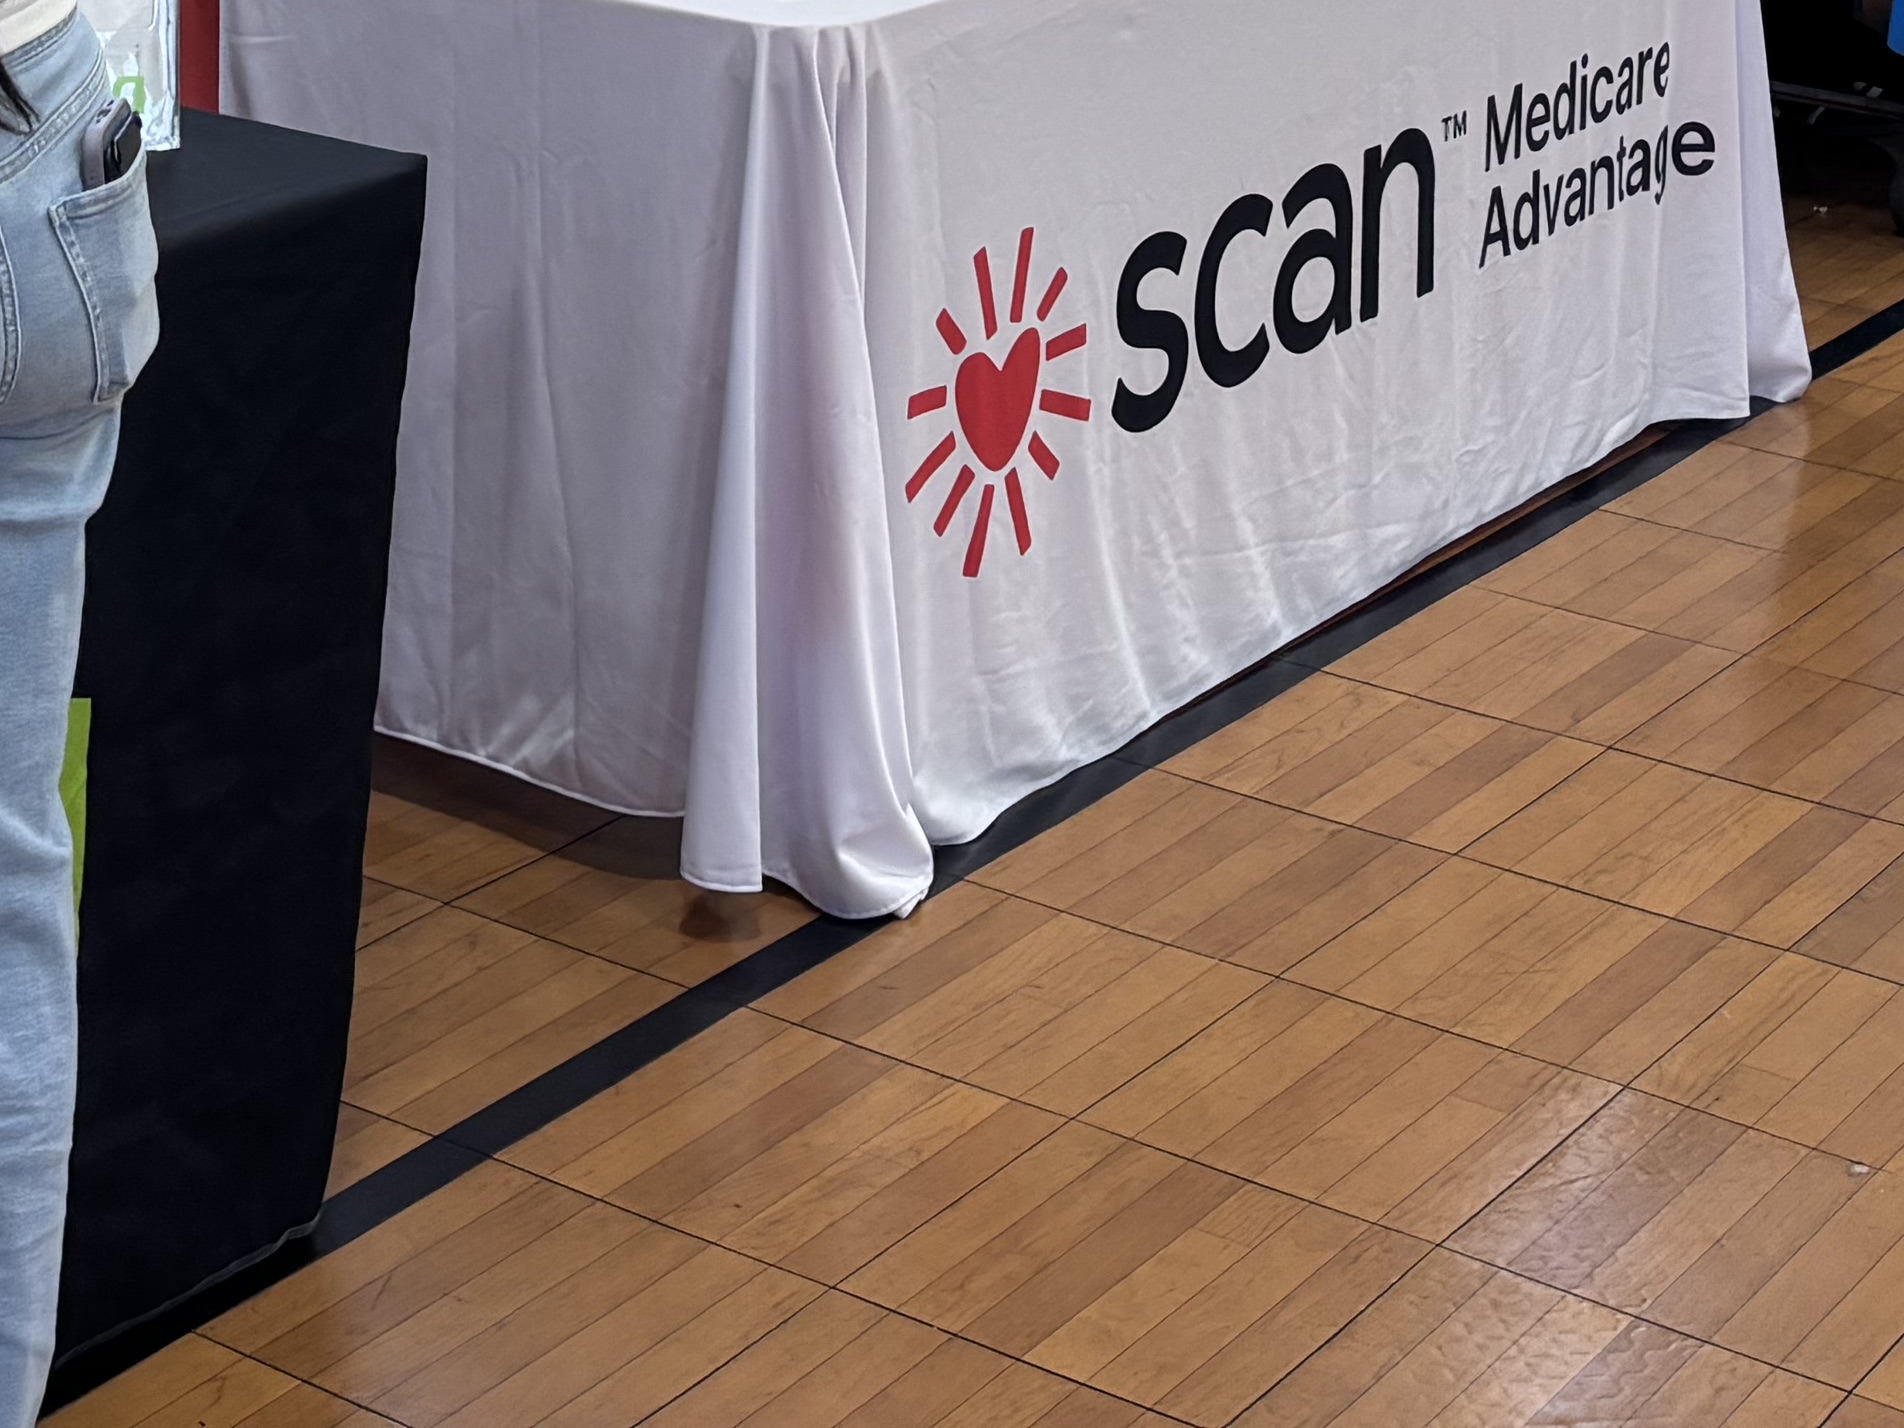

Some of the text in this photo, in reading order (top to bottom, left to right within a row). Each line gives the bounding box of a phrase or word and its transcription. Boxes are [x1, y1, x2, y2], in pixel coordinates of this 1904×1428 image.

[1484, 41, 1670, 172] Medicare
[1478, 121, 1716, 270] Advantage
[1111, 128, 1437, 433] scan
